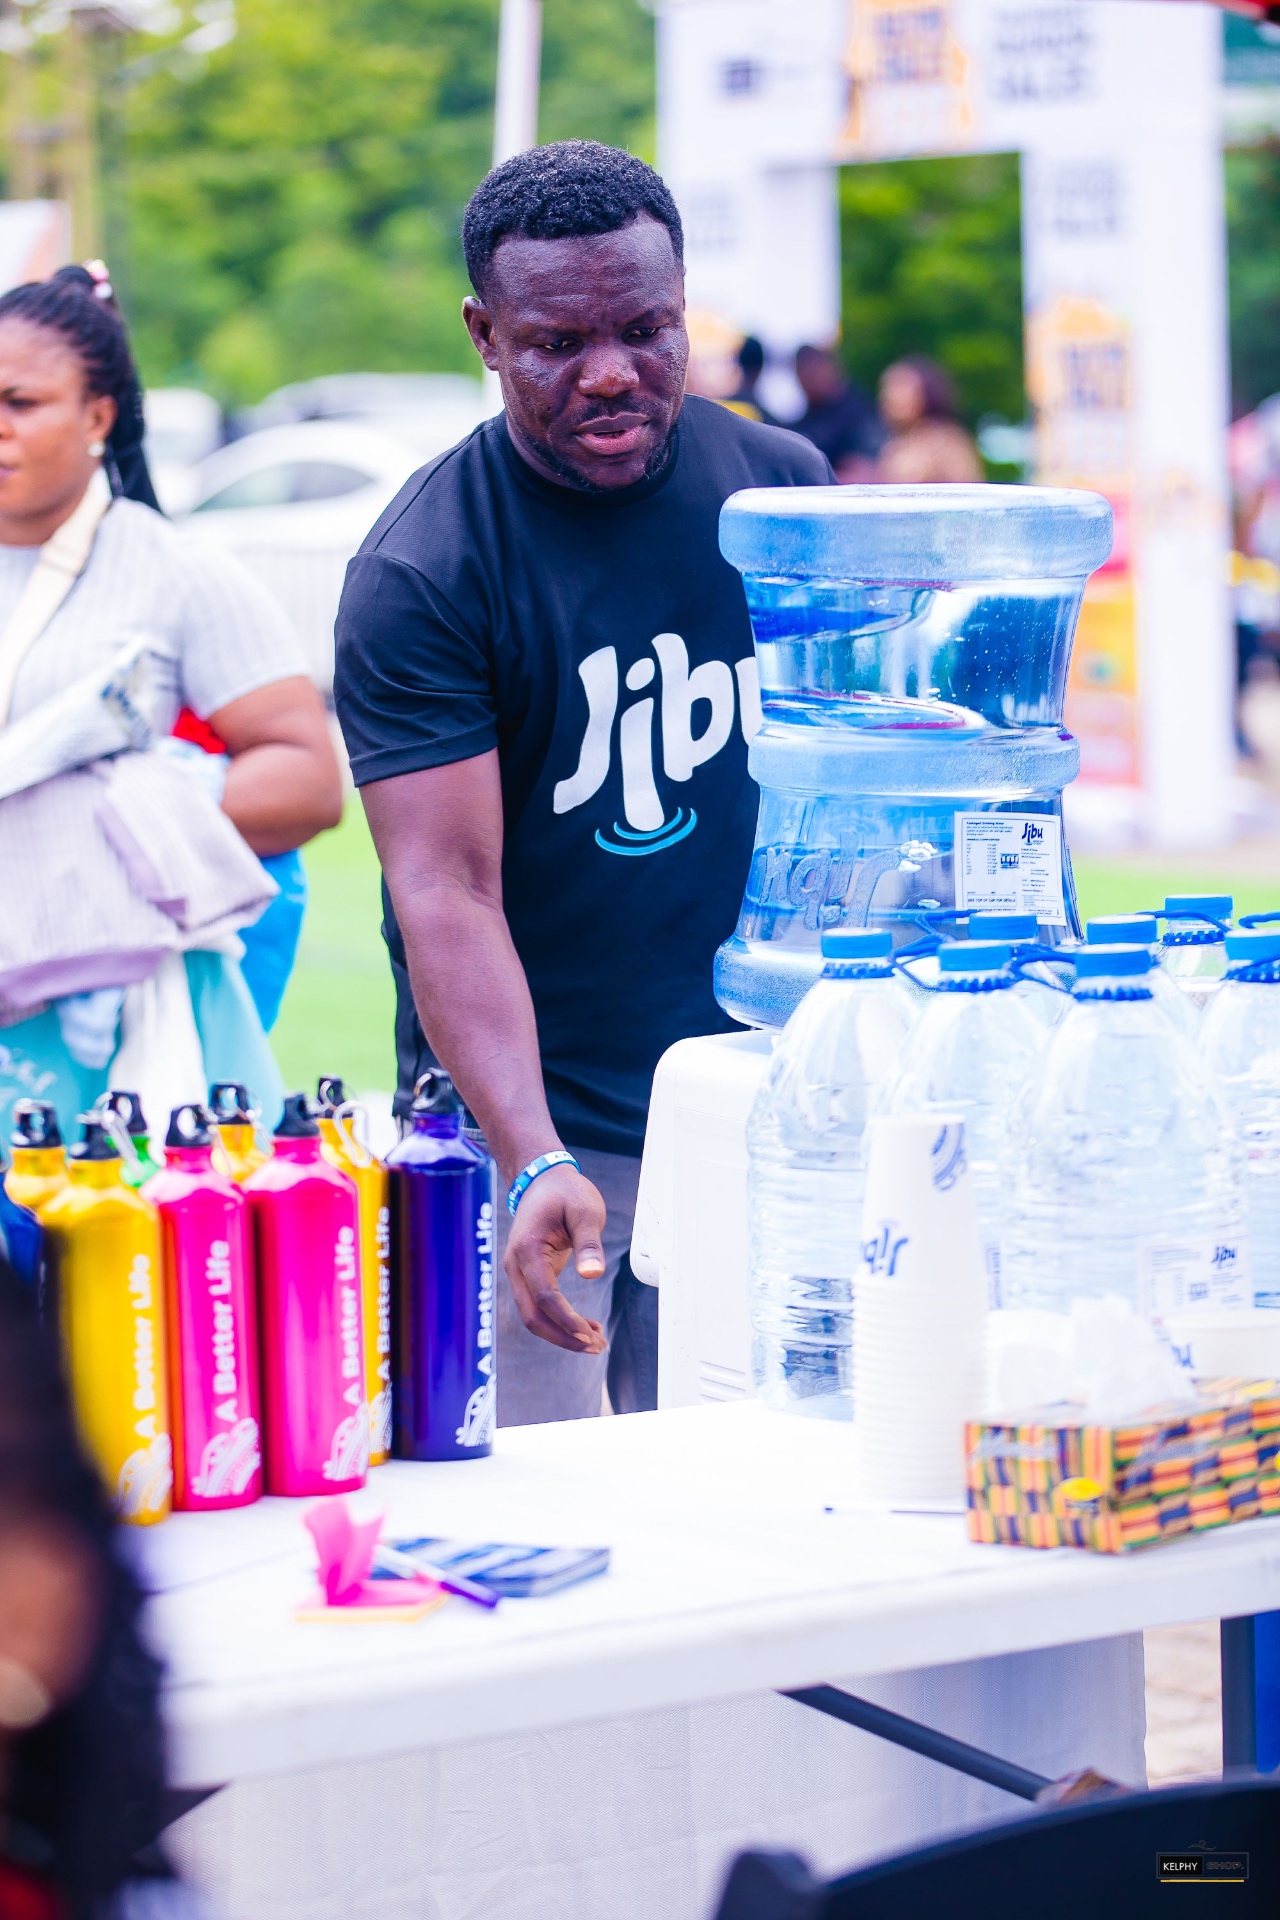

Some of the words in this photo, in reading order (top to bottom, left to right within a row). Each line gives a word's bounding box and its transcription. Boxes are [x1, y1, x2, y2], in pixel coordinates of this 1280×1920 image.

[1021, 822, 1043, 844] Jibu
[334, 1226, 356, 1281] Life
[375, 1206, 390, 1259] Life
[475, 1202, 492, 1254] Life
[862, 1227, 909, 1277] Jib
[129, 1254, 151, 1309] Life
[207, 1240, 231, 1296] Life
[376, 1264, 390, 1354] Better
[476, 1260, 492, 1348] Better
[213, 1301, 236, 1394] Better
[341, 1286, 361, 1378] Better
[135, 1317, 155, 1411] Better
[377, 1359, 390, 1380] A
[477, 1353, 492, 1375] A
[213, 1398, 238, 1422] A
[343, 1383, 361, 1405] A
[134, 1415, 156, 1438] A
